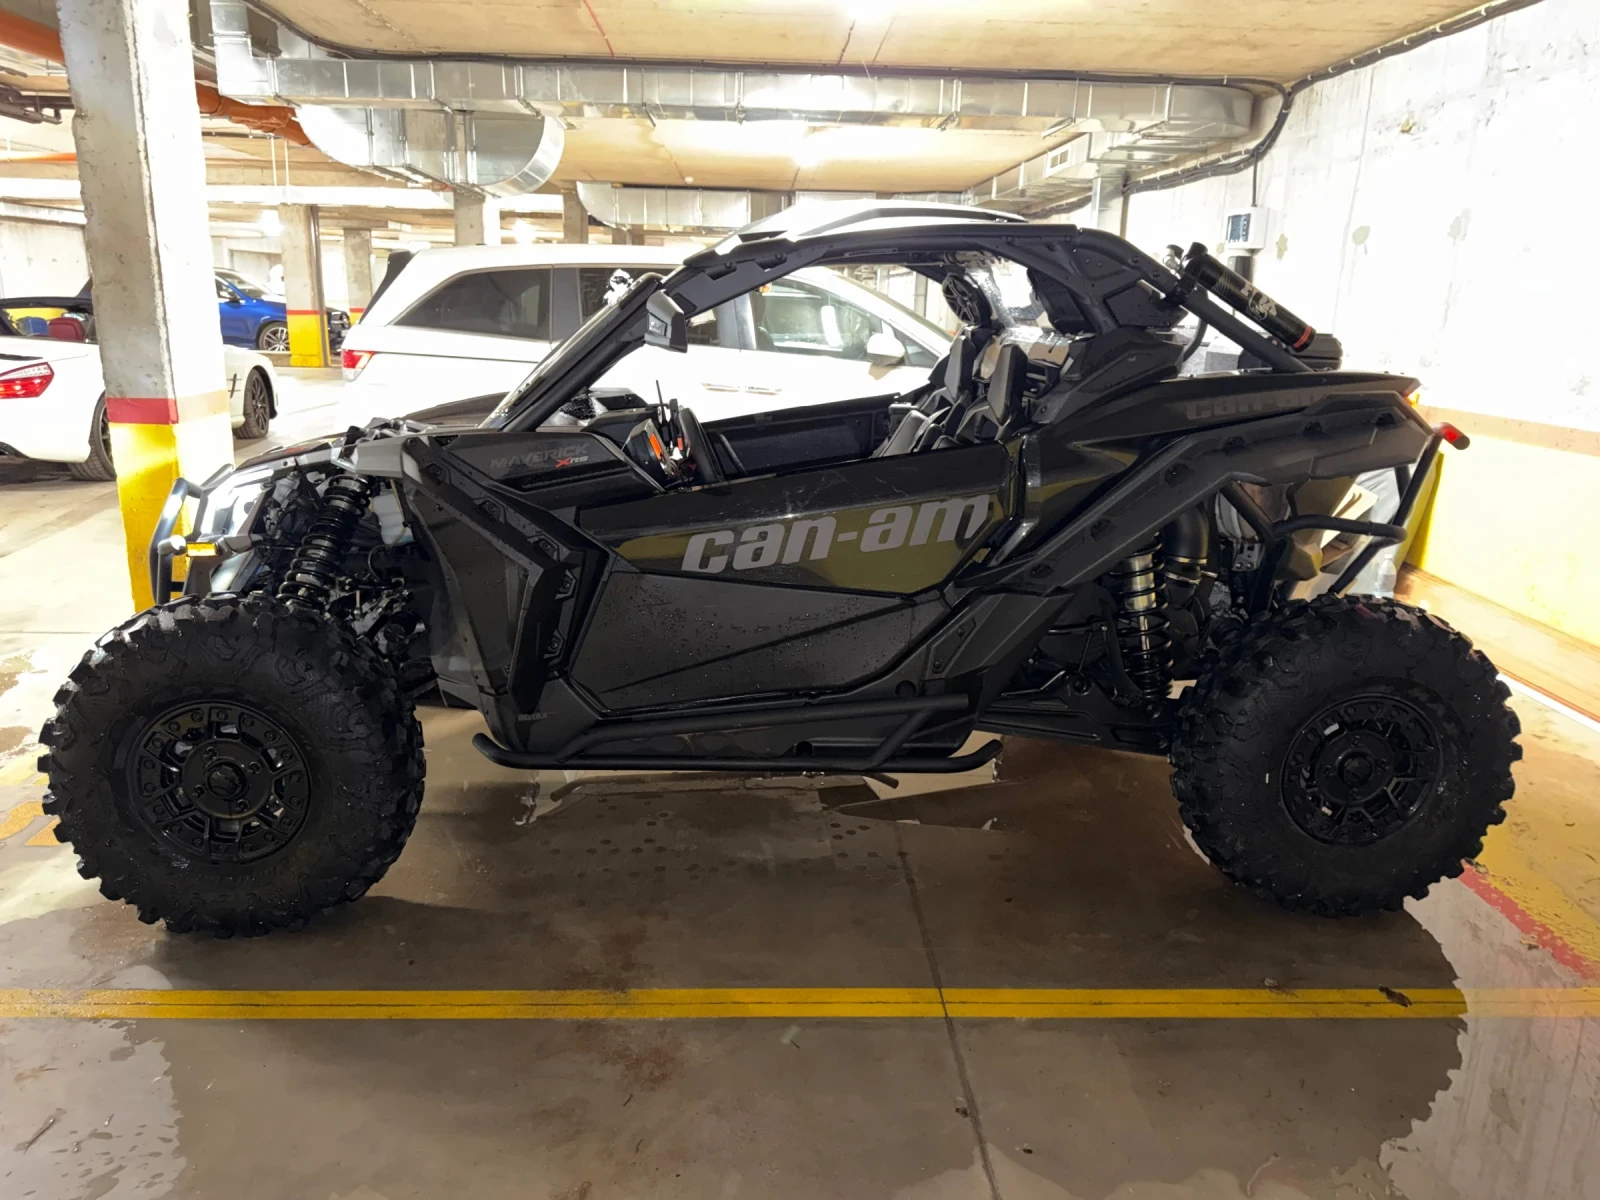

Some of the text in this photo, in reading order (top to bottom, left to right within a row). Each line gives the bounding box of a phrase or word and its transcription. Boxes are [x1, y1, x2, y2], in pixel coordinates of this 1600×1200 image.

[490, 443, 590, 469] MAVERICK
[681, 494, 990, 574] can-am
[518, 711, 549, 722] ROTAX
